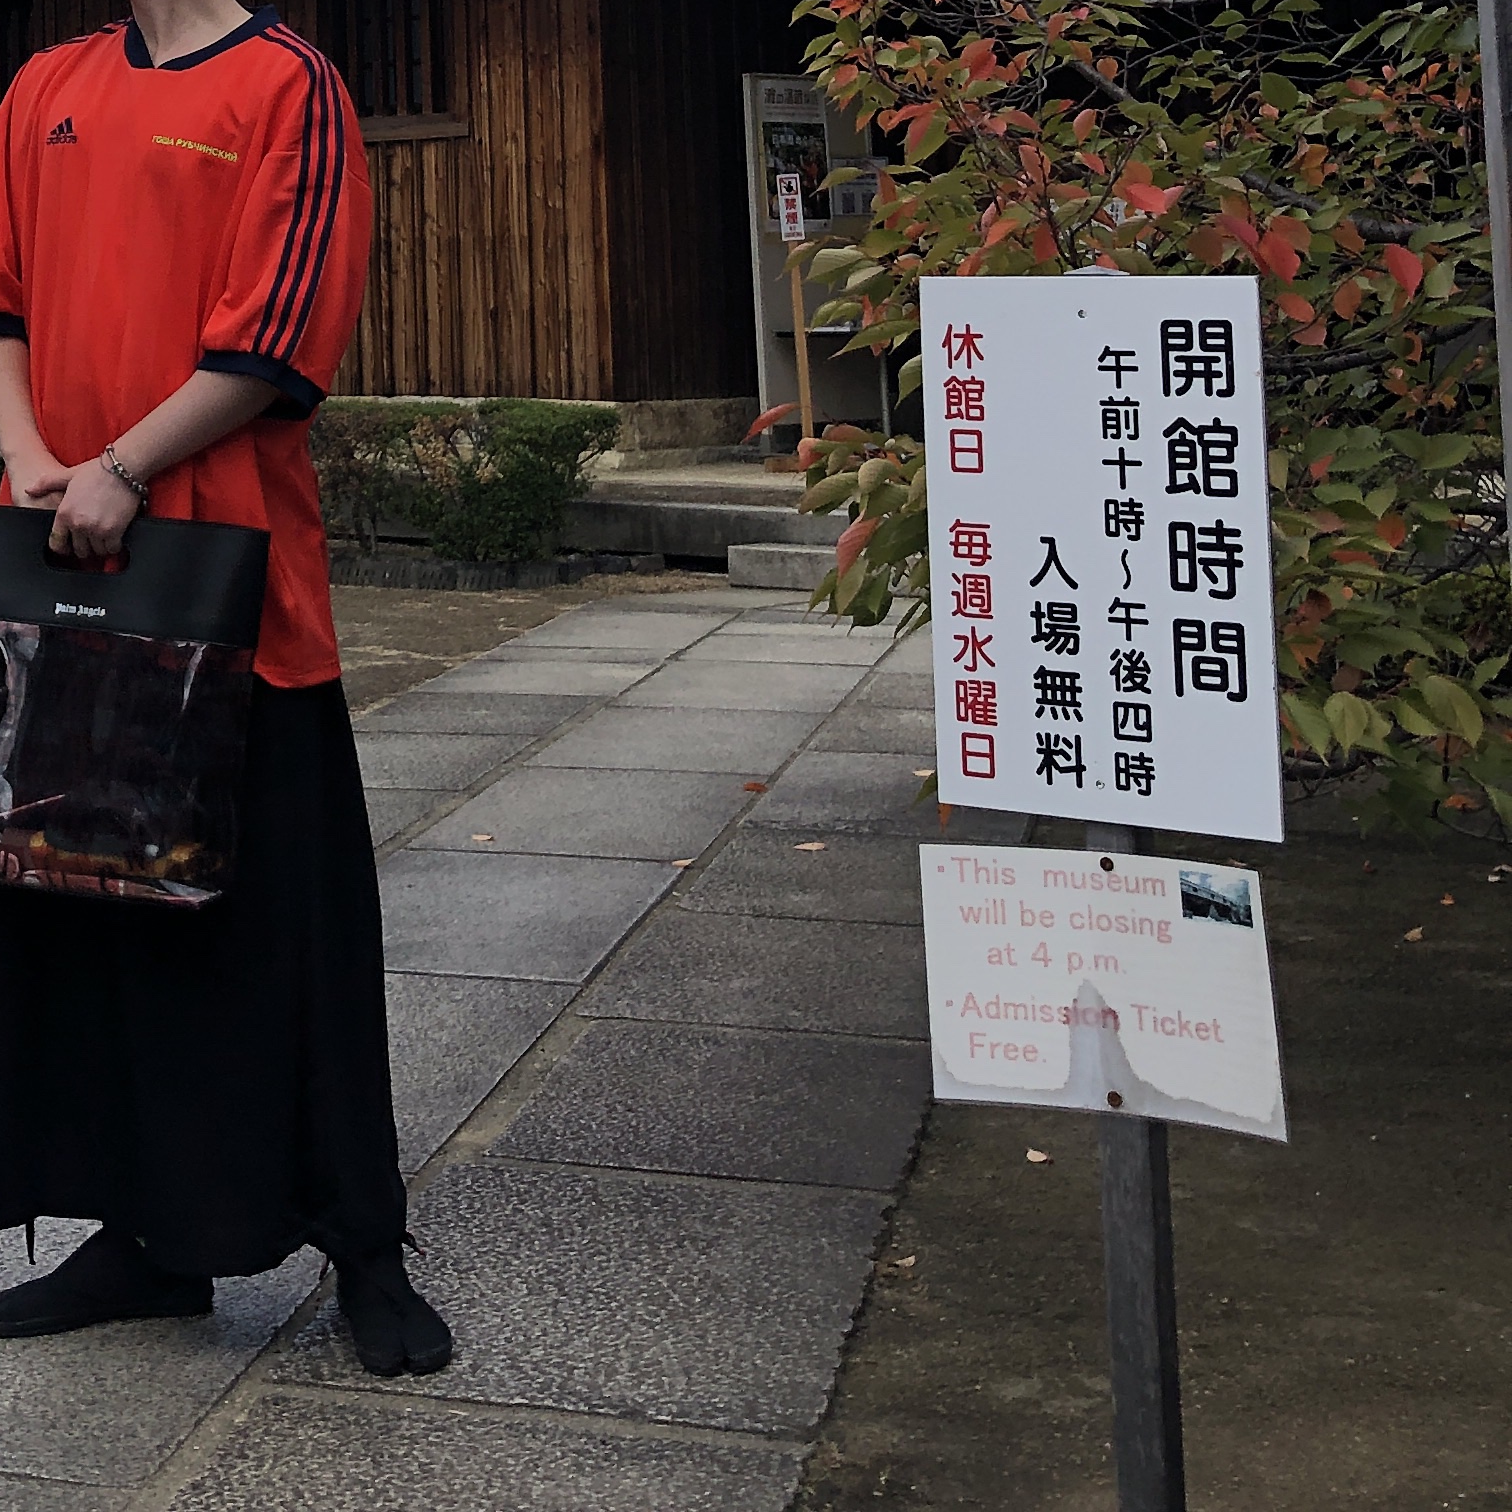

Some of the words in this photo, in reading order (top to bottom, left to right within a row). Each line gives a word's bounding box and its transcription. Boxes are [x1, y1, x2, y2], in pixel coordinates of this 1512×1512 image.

[941, 323, 986, 474] 休館日
[1160, 319, 1248, 703] 開館時間
[948, 518, 999, 781] 毎週水曜日
[1029, 536, 1087, 789] 入場無料
[951, 856, 1016, 886] This
[1043, 868, 1167, 897] museum
[959, 899, 1006, 925] will
[1019, 900, 1055, 928] be
[1069, 903, 1173, 944] closing
[986, 943, 1017, 967] at
[1030, 942, 1052, 968] 4
[960, 992, 1120, 1033] Admission
[1130, 1004, 1225, 1043] Ticket
